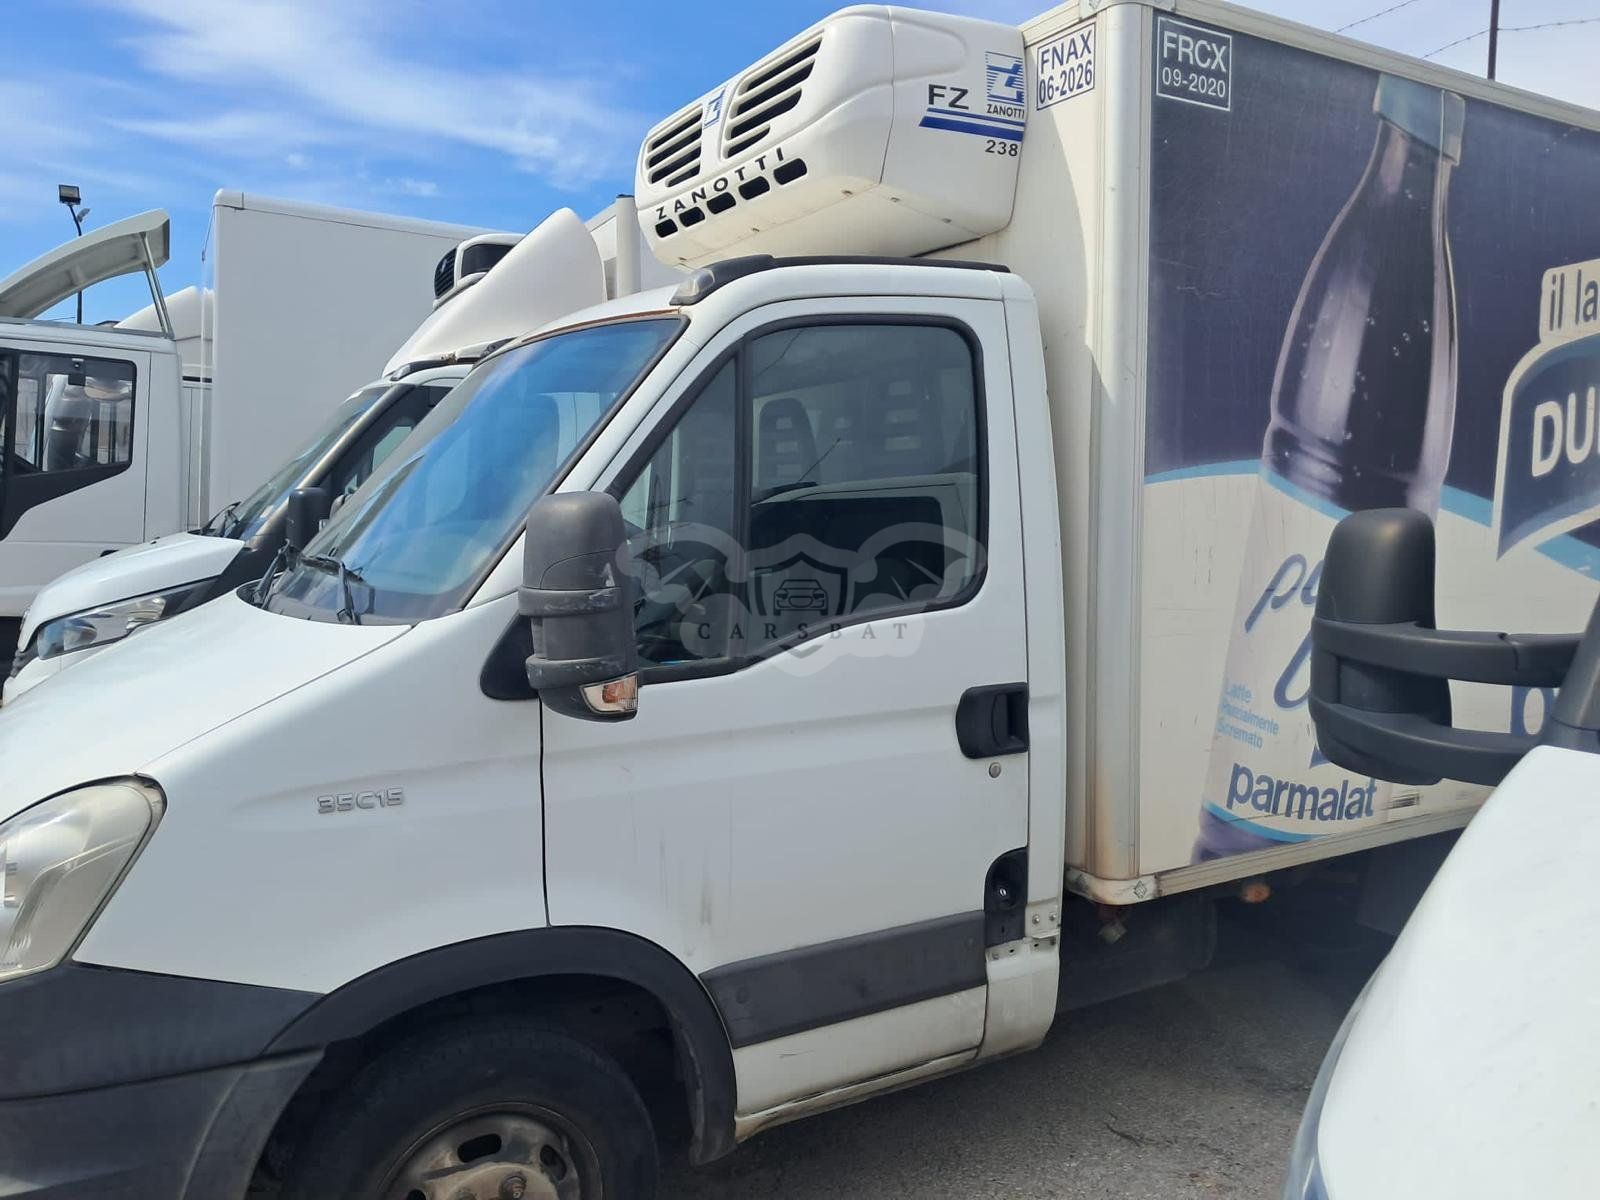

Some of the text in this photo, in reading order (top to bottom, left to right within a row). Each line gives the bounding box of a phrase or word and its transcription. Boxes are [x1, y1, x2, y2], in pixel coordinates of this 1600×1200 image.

[1040, 29, 1093, 74] FNAX
[1163, 30, 1227, 73] FRCX
[928, 84, 969, 110] FZ
[1039, 60, 1093, 104] 06-2026
[1162, 67, 1226, 98] 09-2020
[986, 103, 1025, 119] ZANOTTI
[985, 139, 1018, 157] 238
[656, 147, 784, 219] ZANOTTI
[1532, 386, 1600, 477] DU
[317, 787, 403, 814] 35C15
[1226, 762, 1377, 822] parmalat
